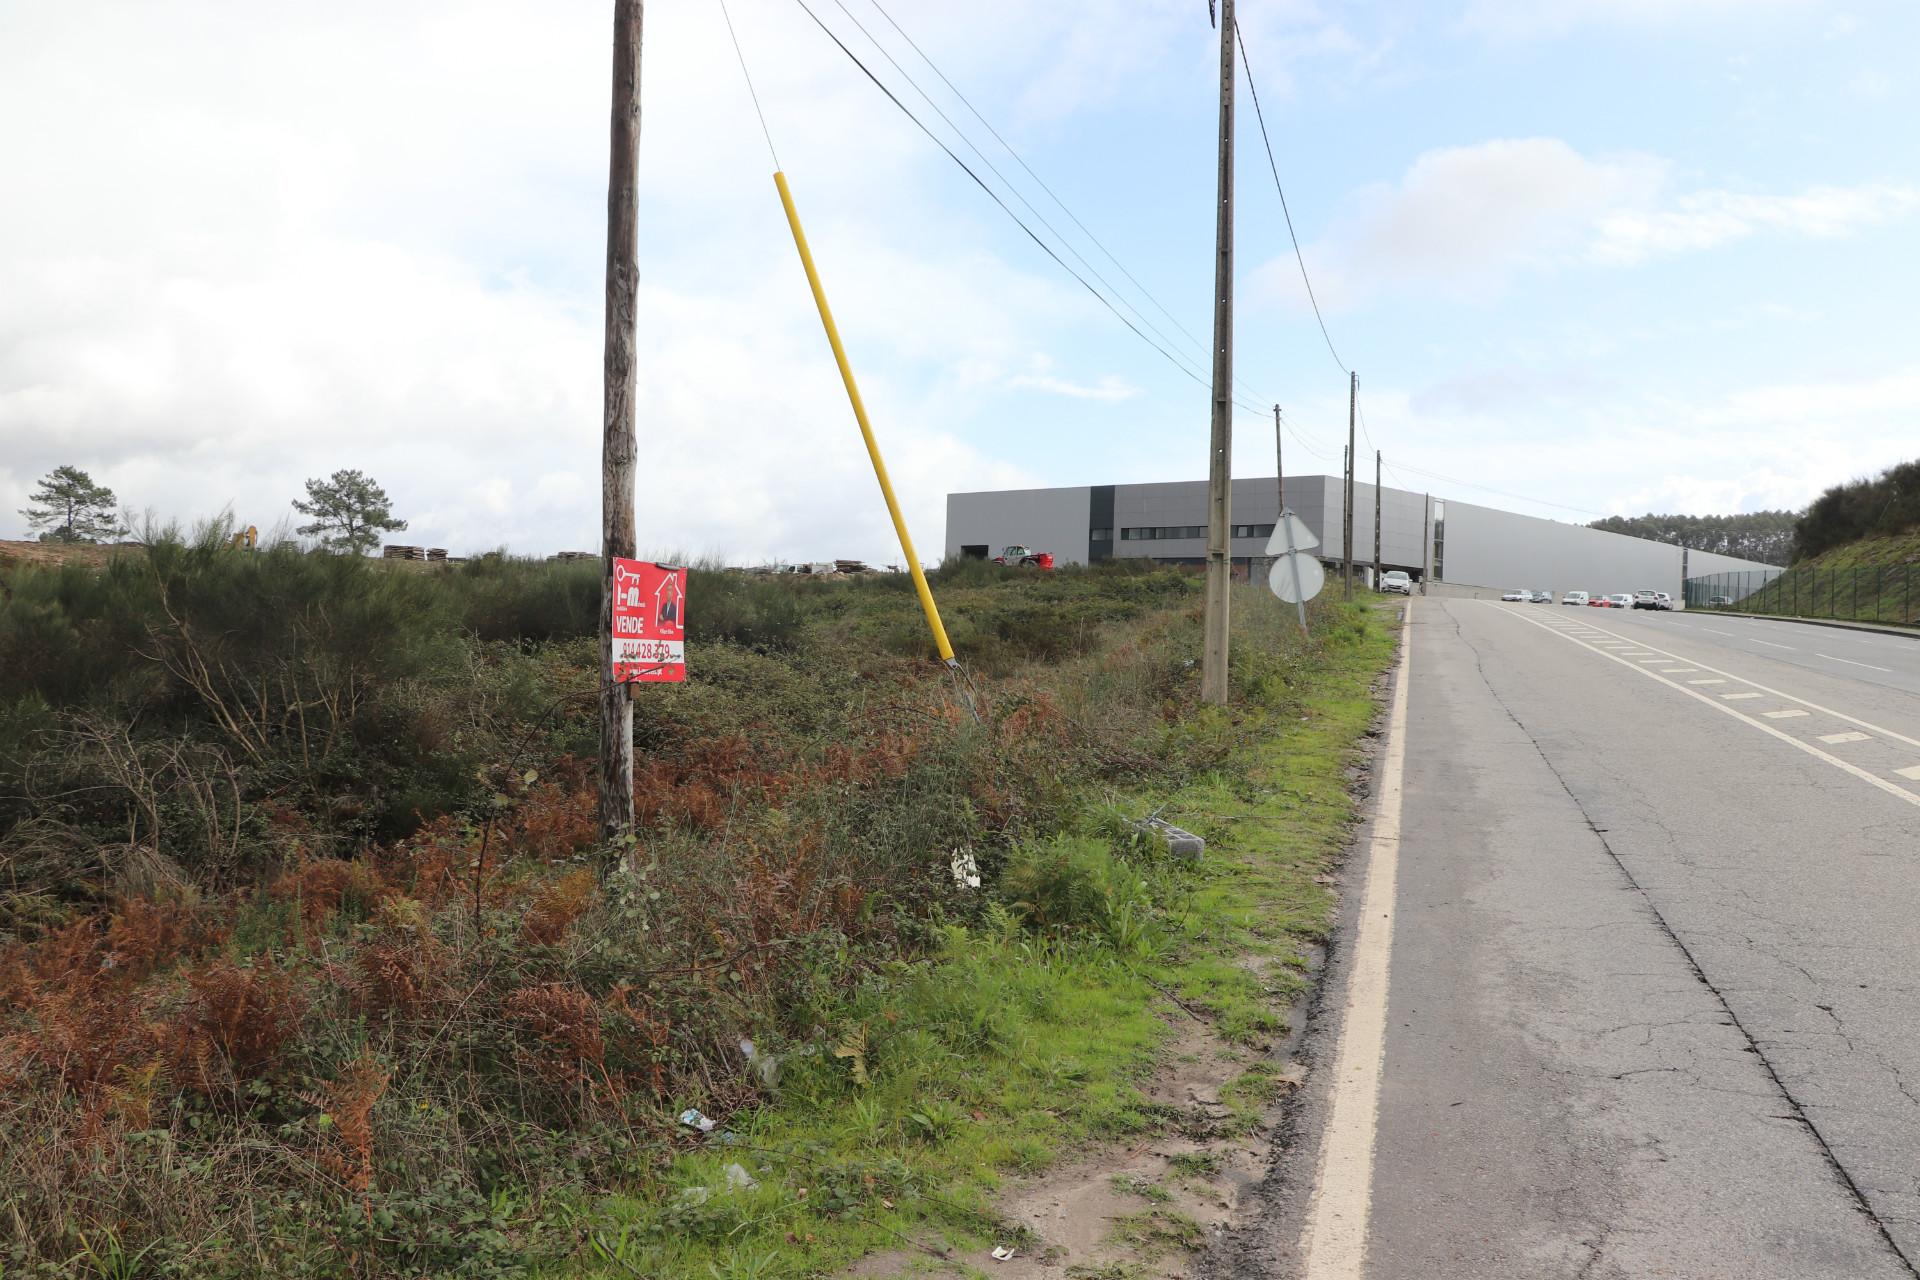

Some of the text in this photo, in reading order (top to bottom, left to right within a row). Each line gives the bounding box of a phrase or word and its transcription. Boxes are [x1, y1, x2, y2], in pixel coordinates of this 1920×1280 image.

[616, 615, 644, 634] VENDE
[636, 642, 652, 659] 428
[654, 643, 670, 659] 379
